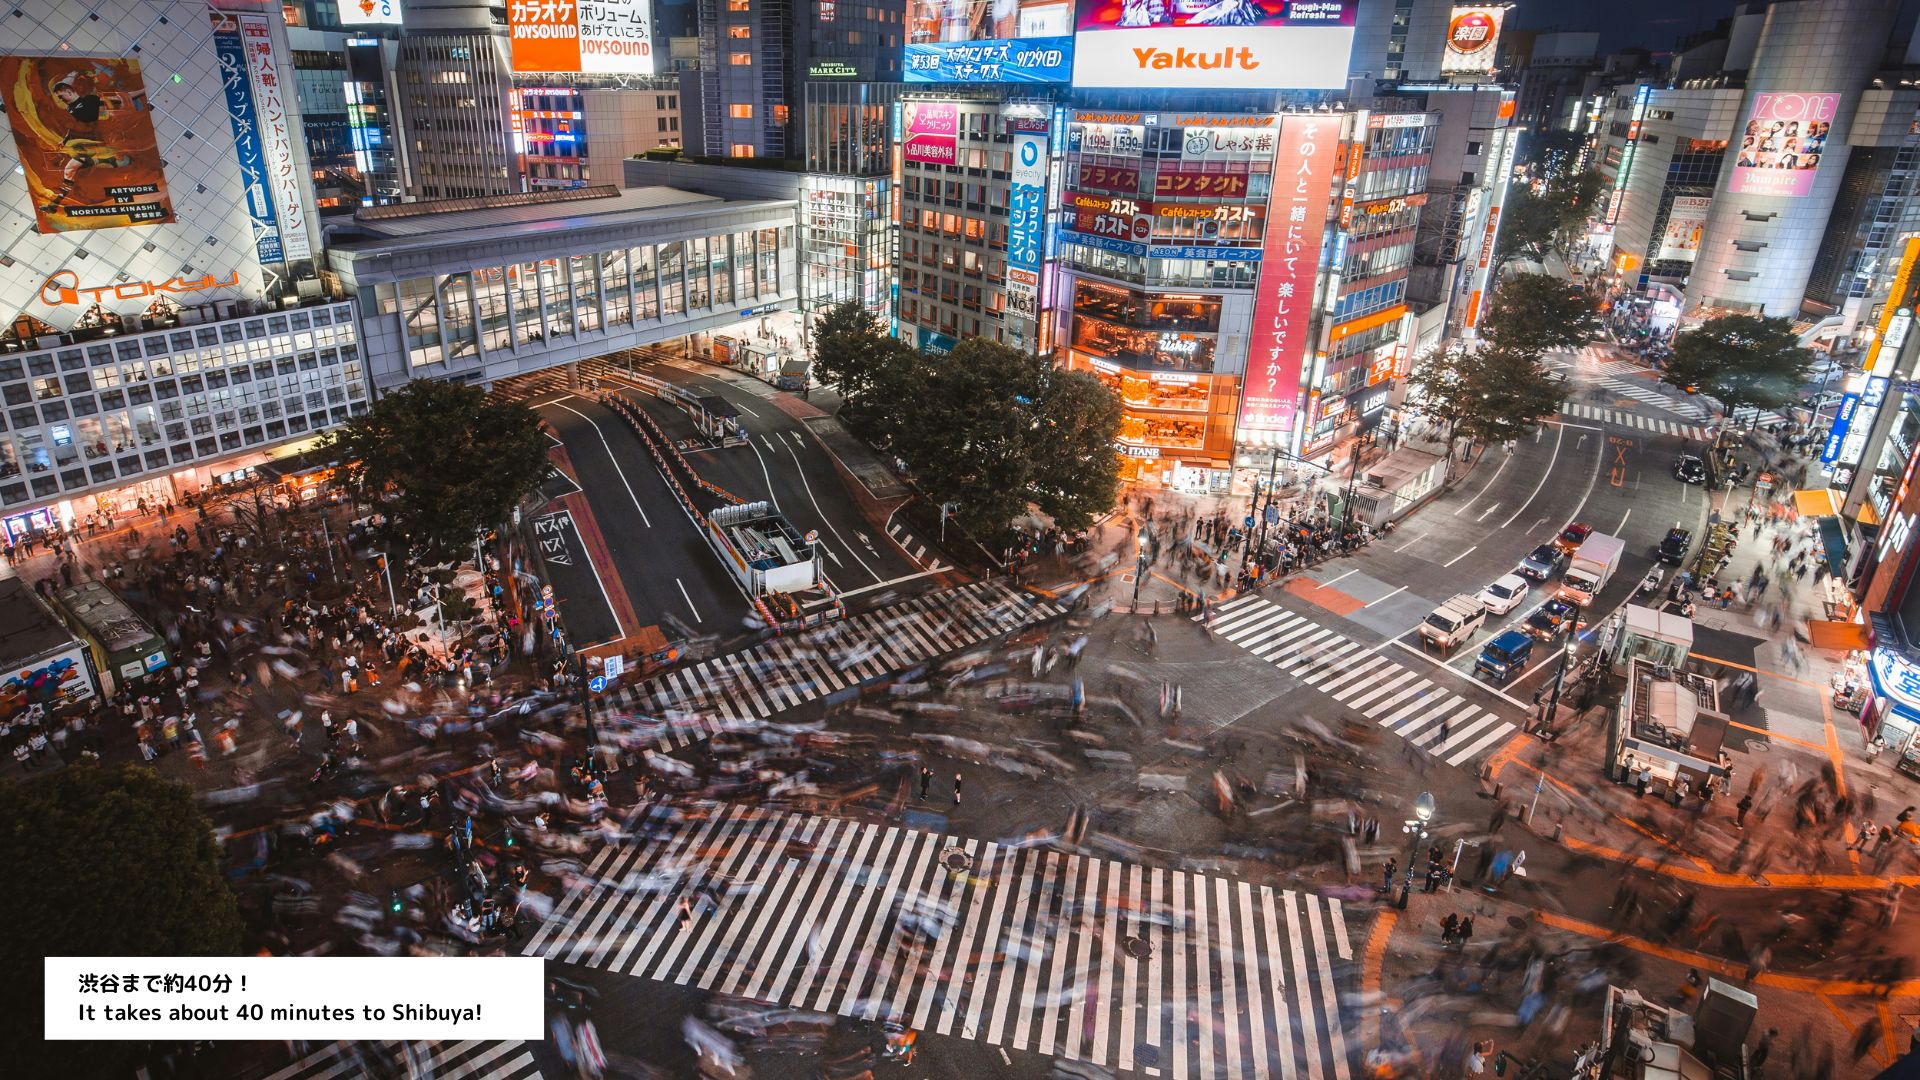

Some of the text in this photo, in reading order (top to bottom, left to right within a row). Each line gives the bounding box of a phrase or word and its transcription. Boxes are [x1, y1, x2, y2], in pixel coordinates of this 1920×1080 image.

[512, 1, 573, 22] カラオケ
[580, 5, 647, 25] ボリューム、
[1290, 10, 1326, 19] Refresh
[1291, 3, 1342, 12] Tough-Man
[513, 24, 577, 39] JOYSOUND
[581, 24, 649, 39] あげていこう。
[582, 40, 650, 56] JOYSOUND
[946, 42, 1012, 63] スプリンターズ
[912, 54, 940, 70] 第53回
[1017, 48, 1062, 68] 9/29(日)
[1133, 47, 1260, 70] Yakult
[835, 66, 856, 74] CITY
[954, 63, 1000, 80] ステークス
[926, 109, 956, 120] 品川スキン
[926, 120, 951, 130] クリニック
[256, 42, 302, 229] 婦人靴・ハンドバッグバーゲン
[1070, 132, 1082, 142] 9F
[1214, 134, 1273, 151] しゃぶ葉
[911, 143, 954, 159] 品川美容外科
[1016, 169, 1042, 182] eyecity
[1157, 175, 1245, 192] コンタクト
[111, 186, 154, 195] ARTWORK
[118, 196, 129, 204] BY
[1110, 199, 1140, 216] ガスト
[71, 204, 156, 217] NORITAKE KINASHI
[1063, 211, 1077, 224] 7F
[1213, 206, 1256, 221] ガスト
[1094, 214, 1129, 237] ガスト
[1081, 236, 1131, 252] 英会話イーオン
[1153, 247, 1179, 257] AEON
[1482, 232, 1494, 262] TaxFree
[1185, 247, 1260, 260] 英会話イーオン
[1266, 123, 1318, 392] その人と一緒にいて、楽しいですか？
[78, 272, 240, 303] TOKYU
[1008, 294, 1037, 315] No.1
[1364, 391, 1388, 412] LUSH
[1255, 412, 1289, 424] tinder
